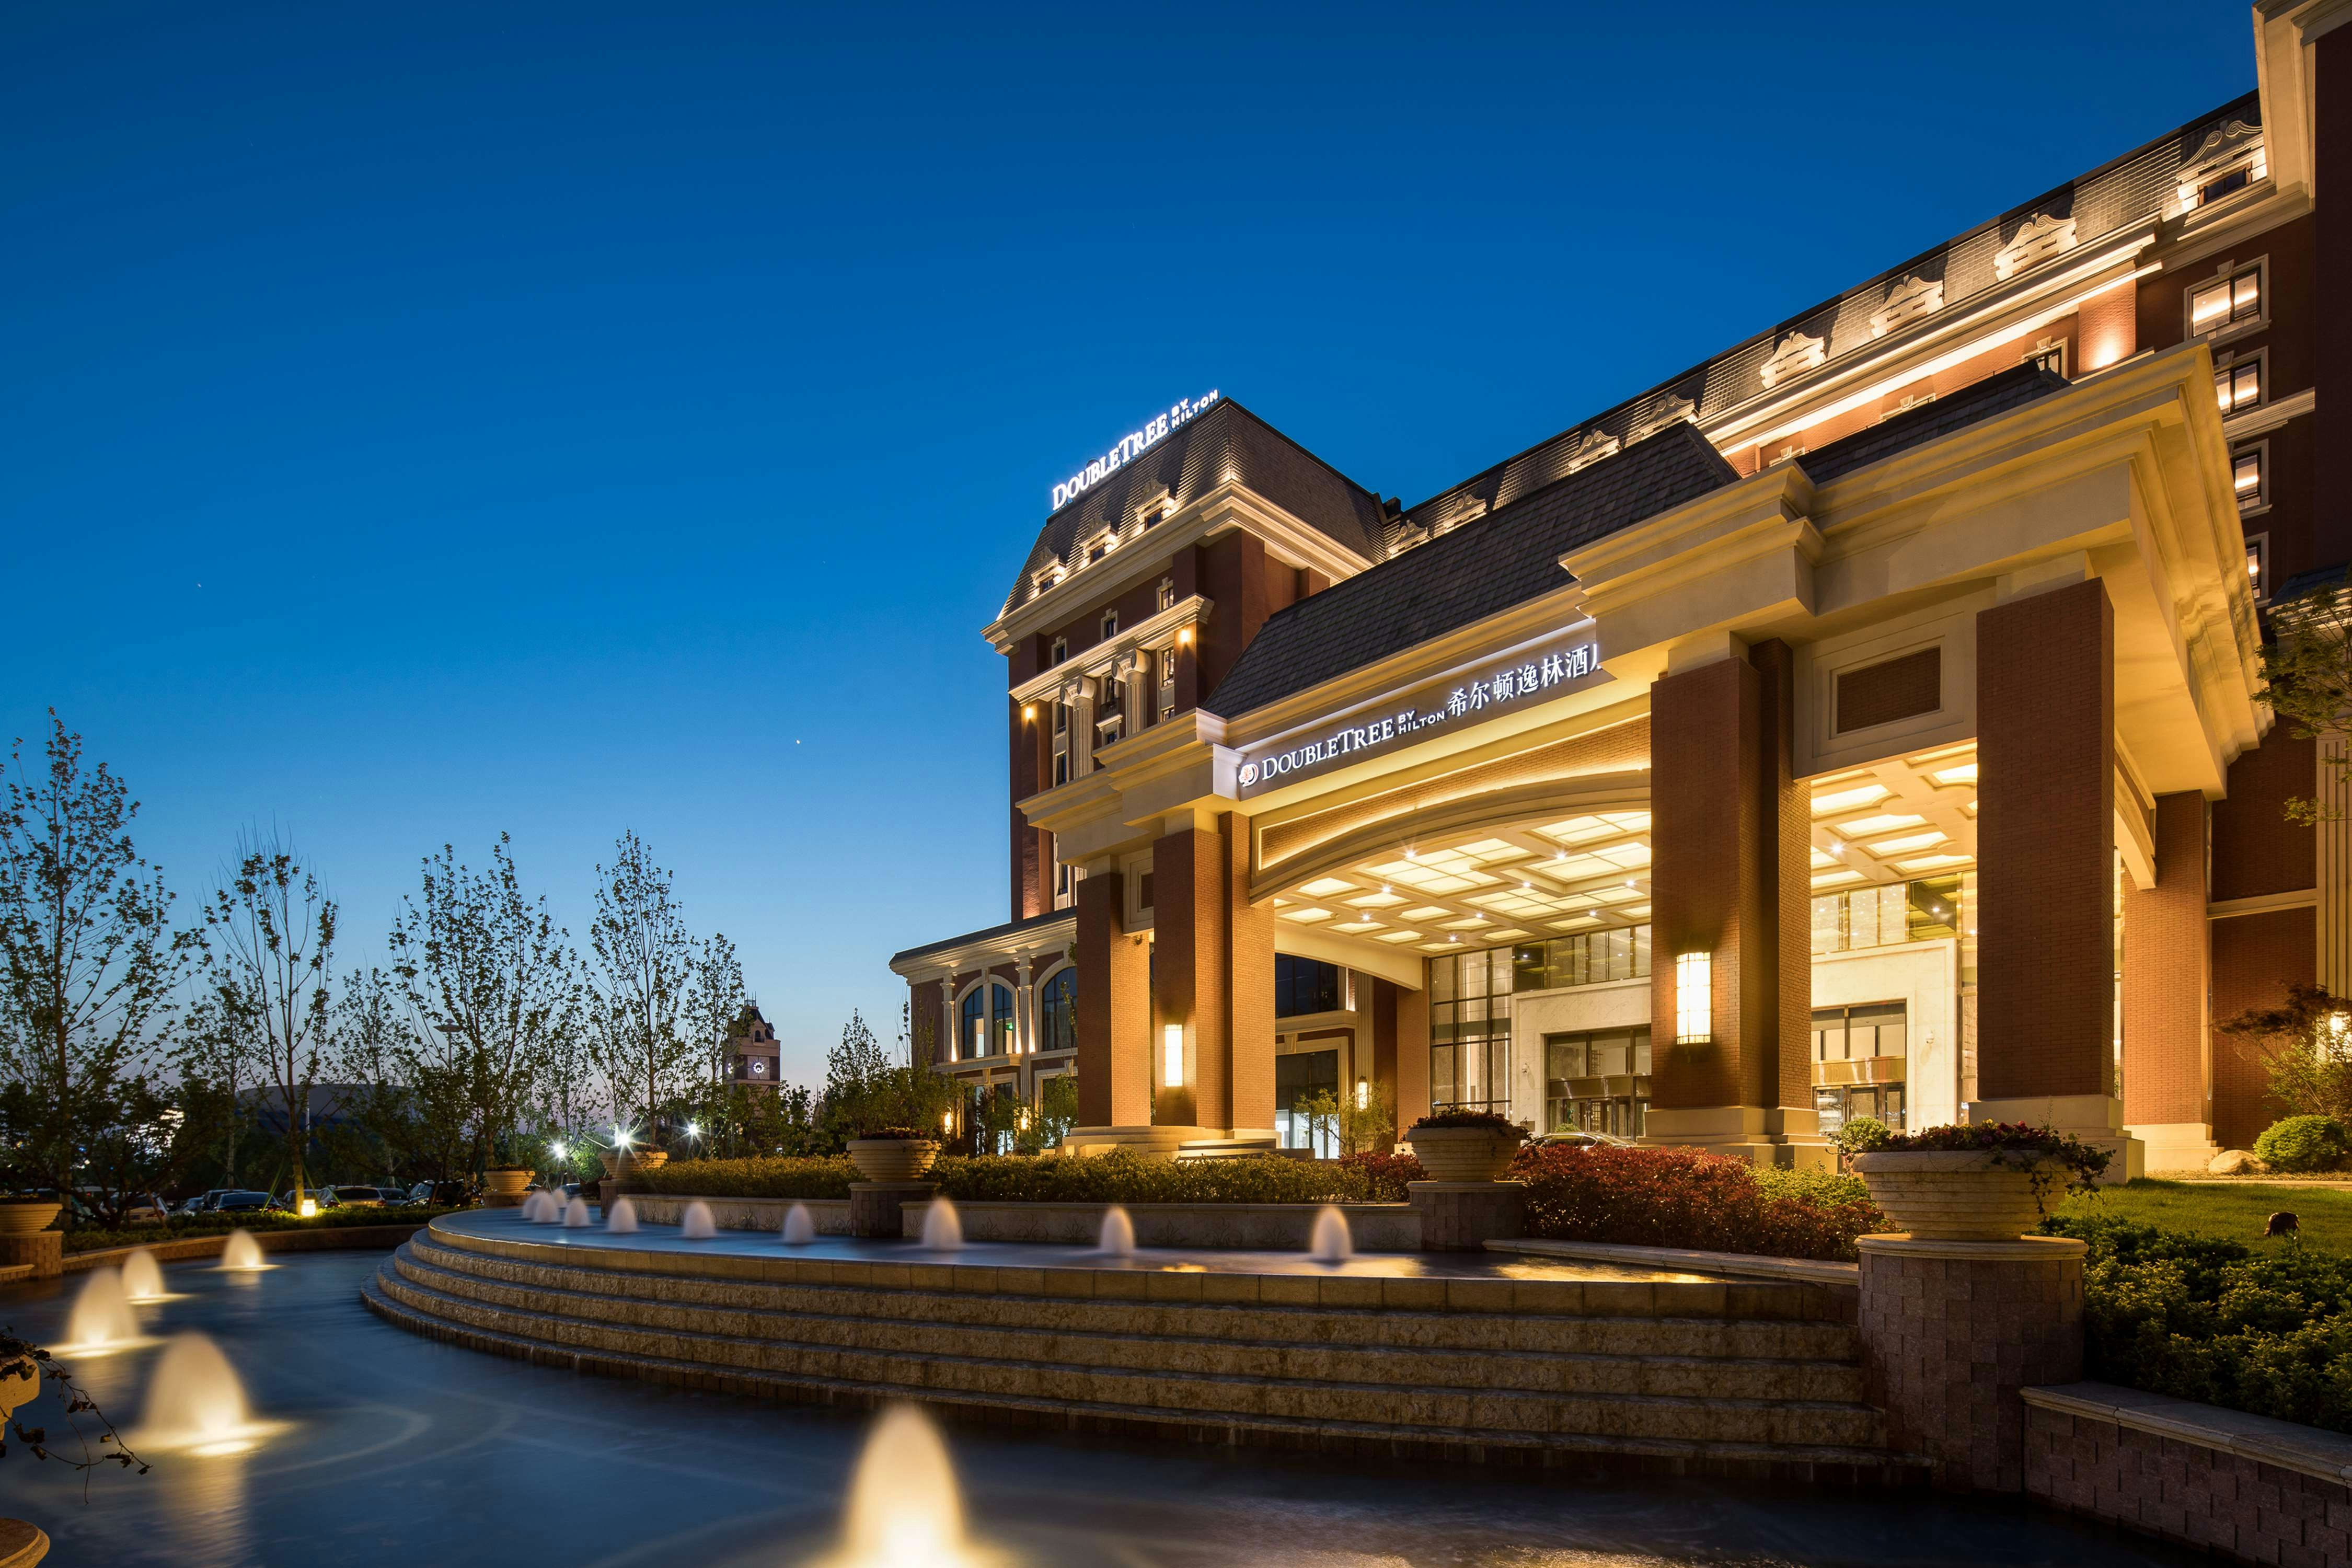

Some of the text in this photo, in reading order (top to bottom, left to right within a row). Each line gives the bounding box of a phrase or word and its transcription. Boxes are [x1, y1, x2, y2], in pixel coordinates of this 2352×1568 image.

[1172, 398, 1189, 417] BY
[1172, 389, 1219, 428] HILTON
[1052, 413, 1169, 510] DOUBLETREE
[1447, 643, 1601, 717] 希尔顿逸林酒
[1398, 710, 1415, 724] BY
[1398, 710, 1445, 734] HILTON
[1262, 718, 1394, 780] DOUBLETREE
